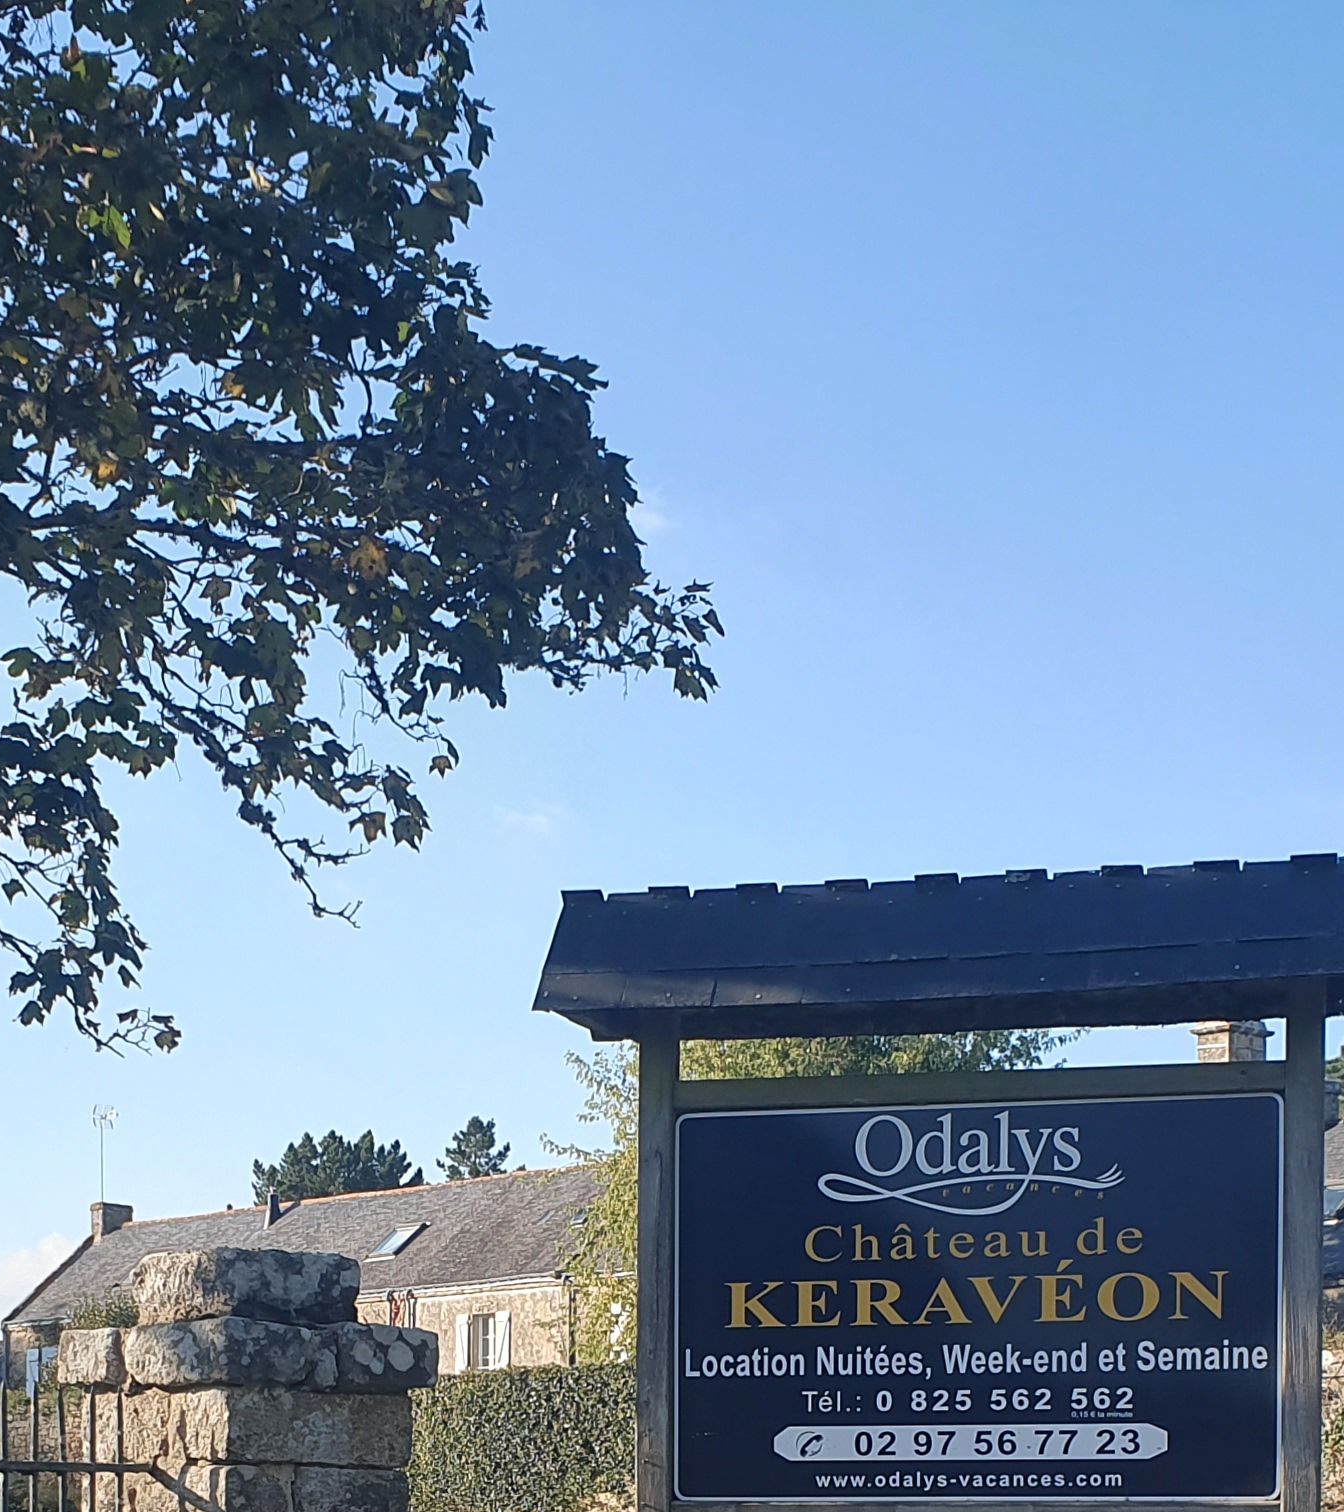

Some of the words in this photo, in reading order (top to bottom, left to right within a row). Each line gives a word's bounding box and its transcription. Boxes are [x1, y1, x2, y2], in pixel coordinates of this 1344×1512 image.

[854, 1110, 1082, 1178] Odalys
[942, 1179, 1106, 1201] vacances
[804, 1221, 1050, 1263] Château
[1075, 1215, 1144, 1256] de
[724, 1258, 1230, 1330] KERAVÉON
[684, 1347, 806, 1378] Location
[816, 1344, 933, 1381] Nuitées,
[942, 1341, 1088, 1375] Week-end
[1097, 1342, 1127, 1372] et
[1135, 1338, 1269, 1372] Semaine
[801, 1390, 863, 1413] Tél.:
[875, 1389, 894, 1412] 0
[909, 1388, 973, 1412] 825
[989, 1387, 1053, 1411] 562
[1069, 1386, 1135, 1410] 562
[1070, 1410, 1089, 1419] 0,15
[854, 1430, 897, 1457] 02
[912, 1430, 957, 1457] 97
[972, 1429, 1018, 1456] 56
[1033, 1429, 1079, 1455] 77
[1095, 1428, 1142, 1455] 23
[815, 1471, 1124, 1492] www.odalys-vacances.com
